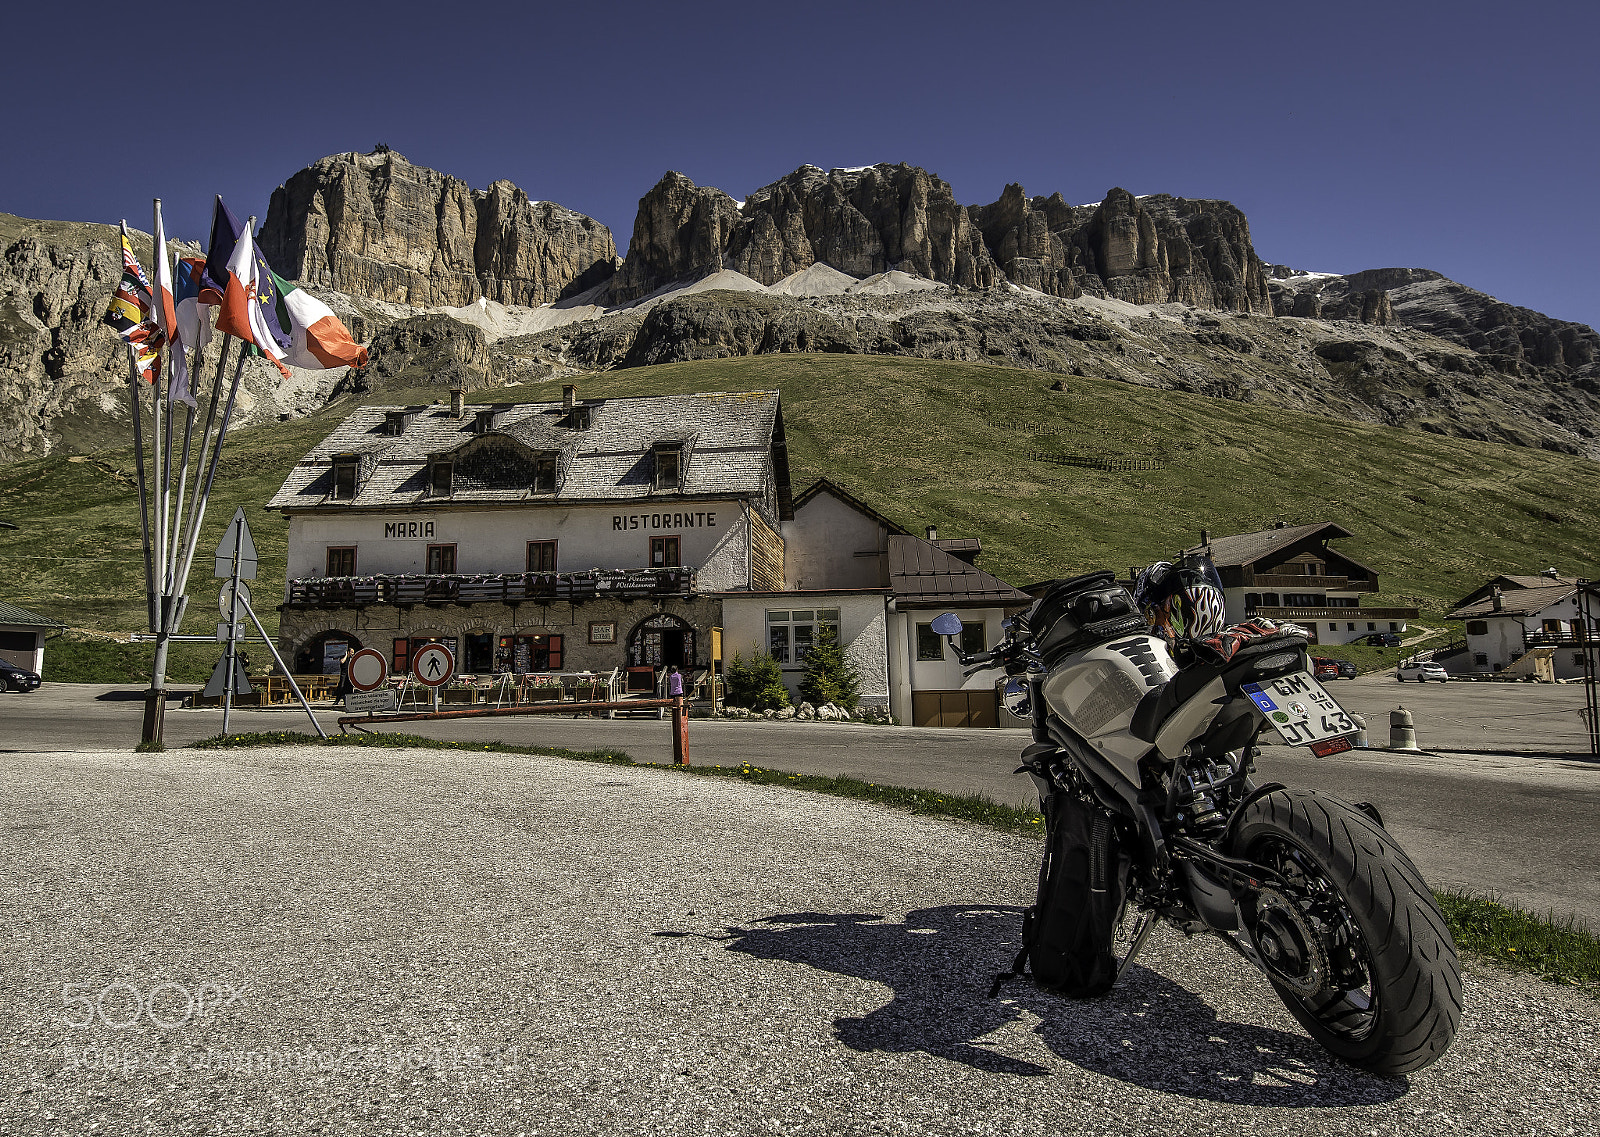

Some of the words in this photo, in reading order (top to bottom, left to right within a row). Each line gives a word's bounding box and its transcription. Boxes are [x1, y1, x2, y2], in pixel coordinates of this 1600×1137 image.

[385, 521, 435, 538] MARIA
[613, 512, 717, 531] RISTORANTE
[1271, 674, 1311, 696] GM
[1282, 720, 1316, 743] JT
[1321, 712, 1353, 734] 43
